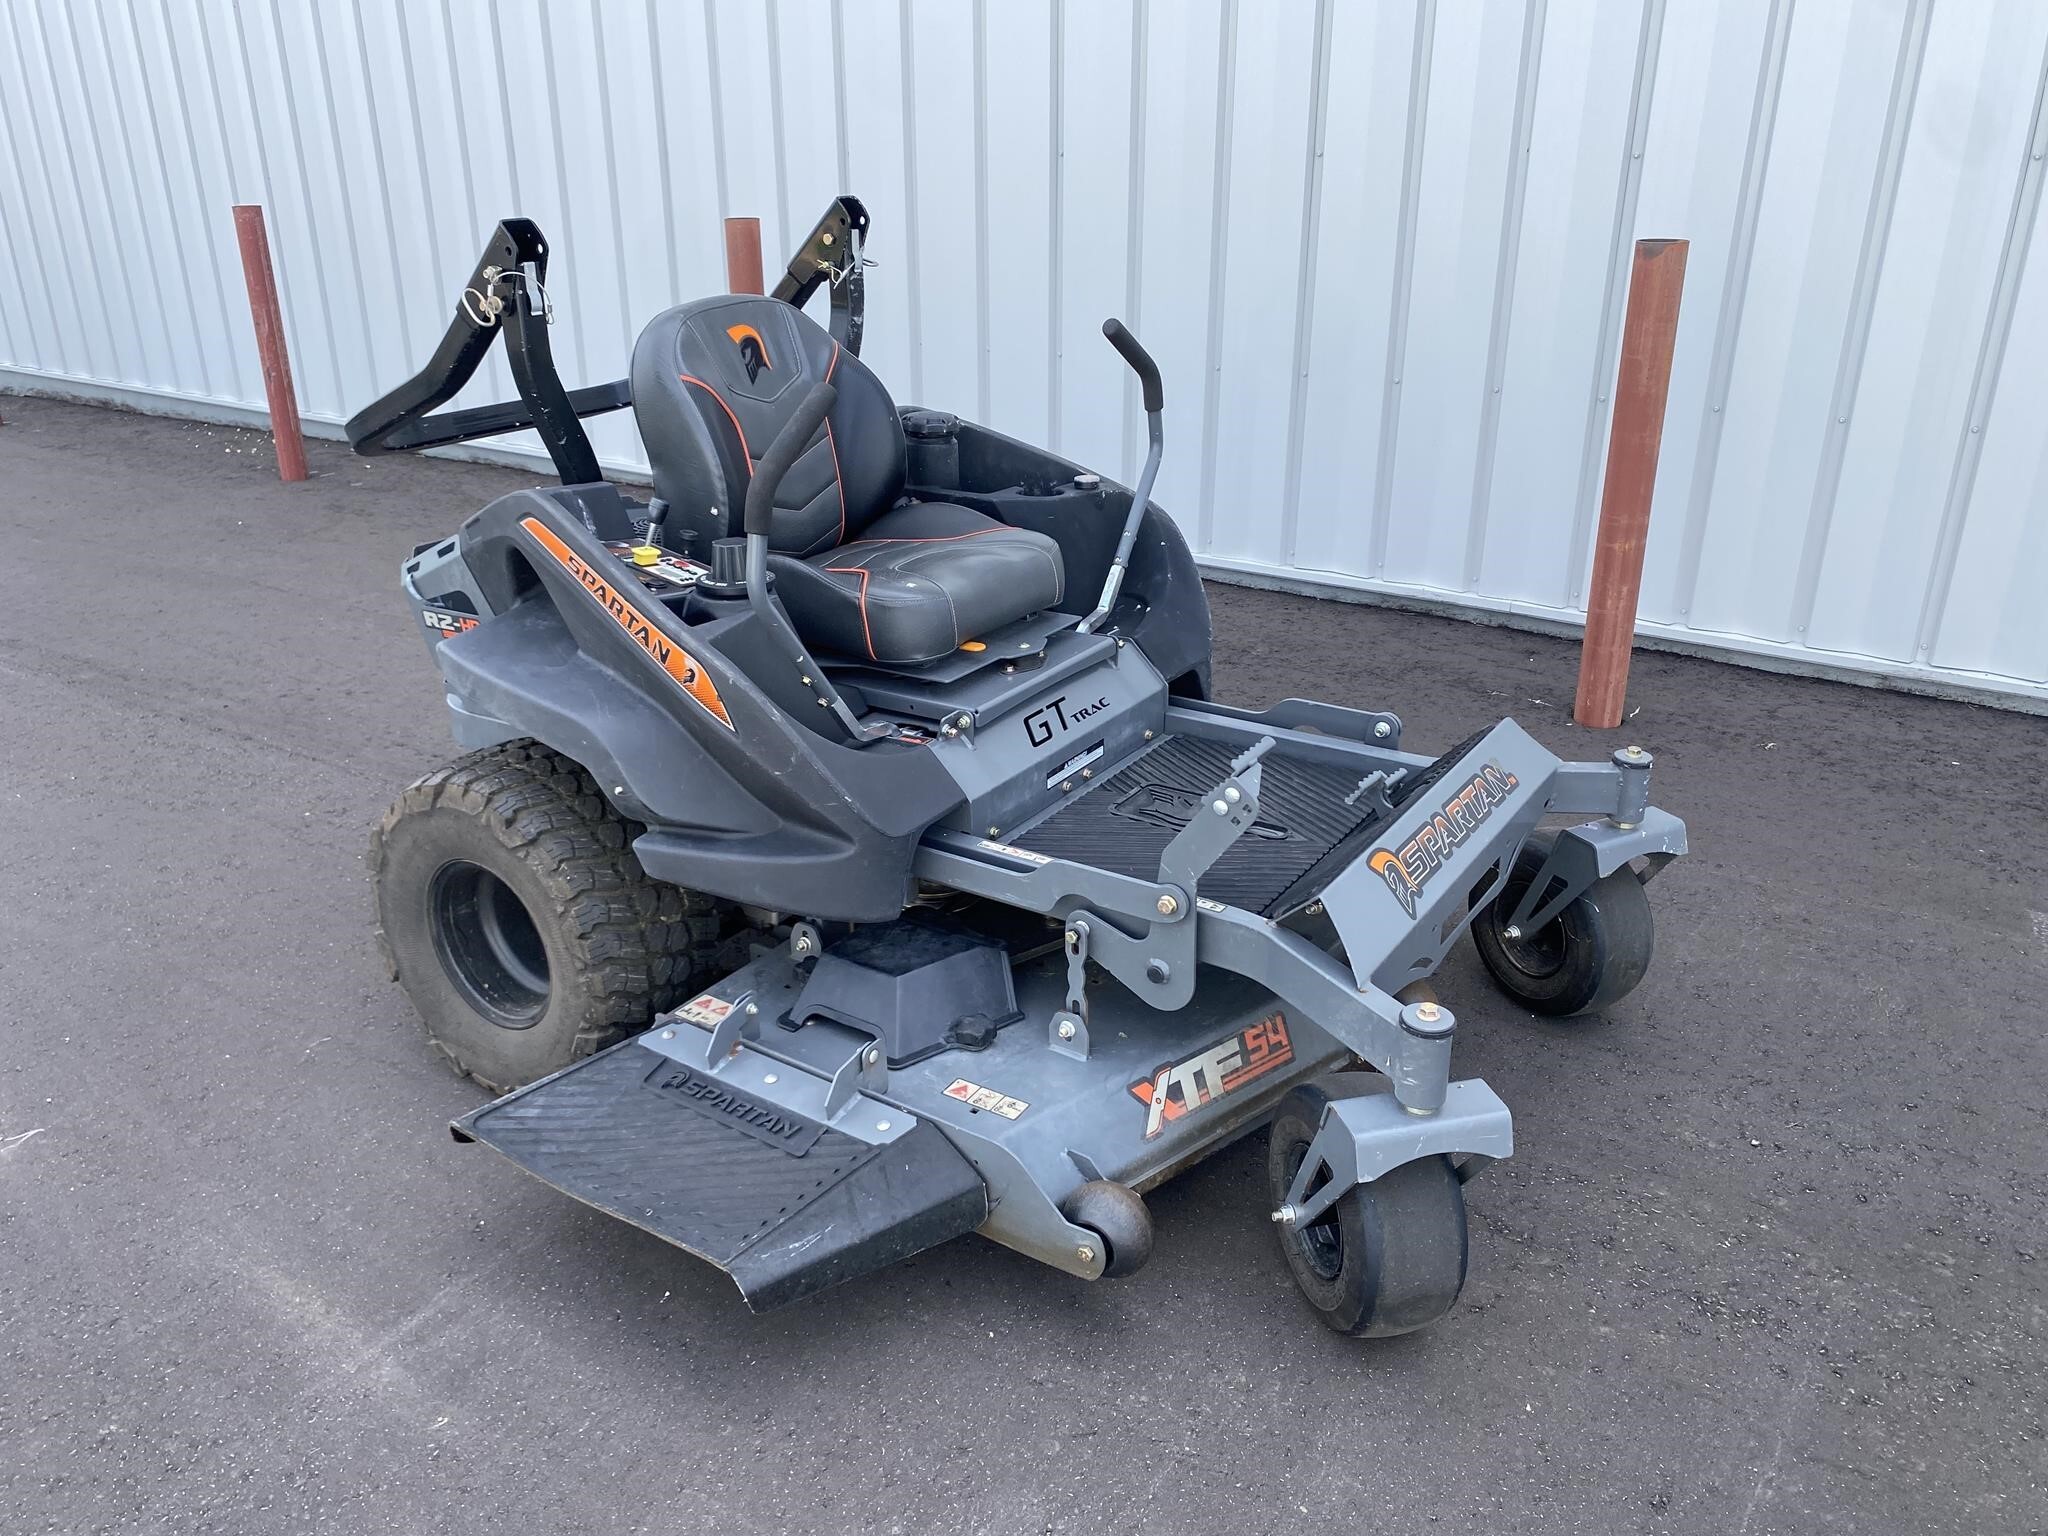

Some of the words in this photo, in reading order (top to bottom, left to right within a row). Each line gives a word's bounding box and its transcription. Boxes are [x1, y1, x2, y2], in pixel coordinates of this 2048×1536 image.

[567, 556, 671, 666] SPARTAN
[1023, 695, 1069, 748] GT
[1070, 696, 1111, 724] TRAC
[1398, 765, 1512, 886] SPARTAN
[680, 1081, 803, 1140] SPARTAN
[1130, 1036, 1244, 1138] XTF
[1244, 1015, 1289, 1063] 54
